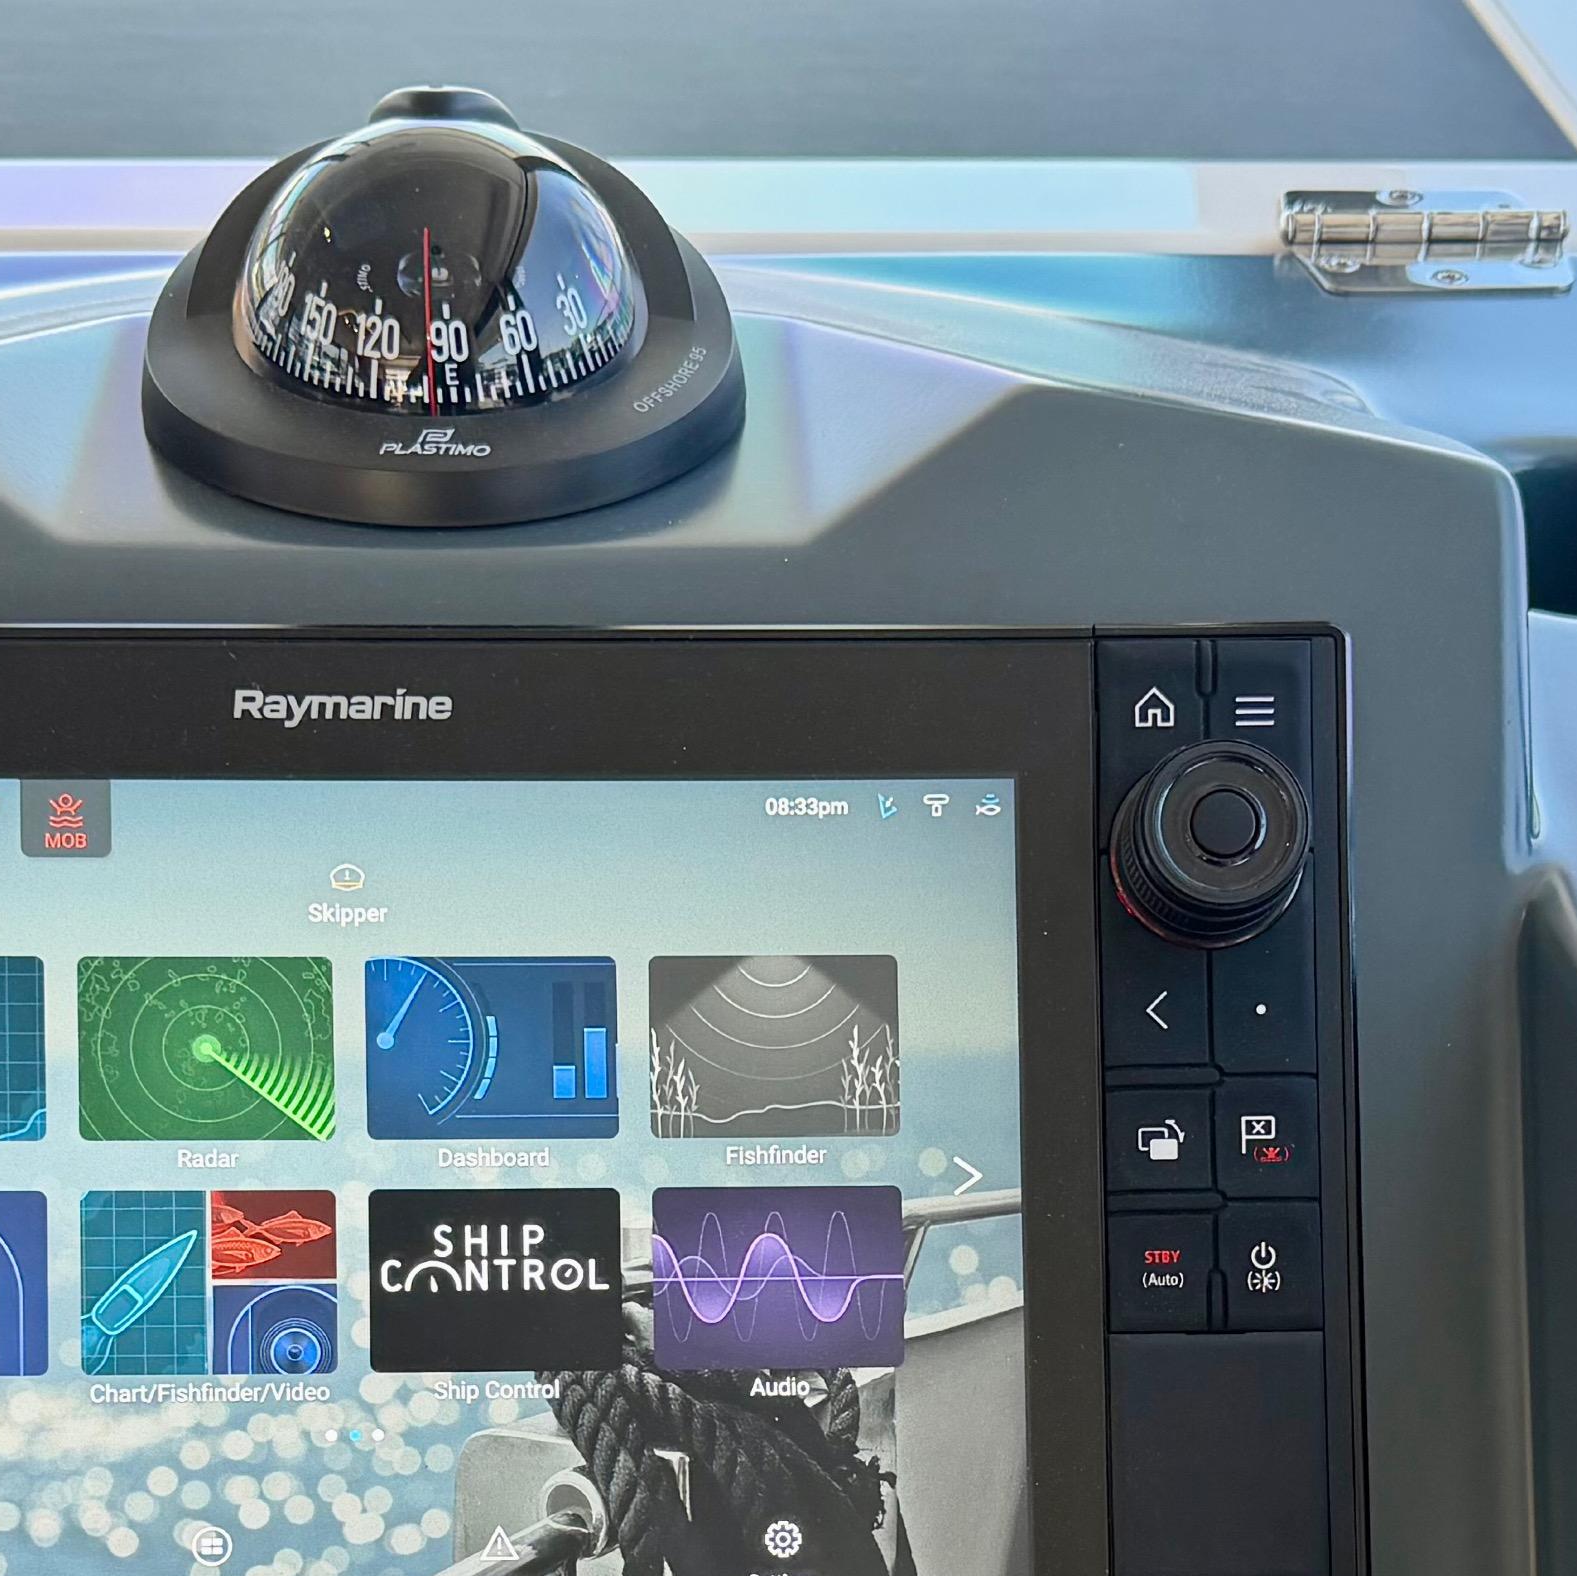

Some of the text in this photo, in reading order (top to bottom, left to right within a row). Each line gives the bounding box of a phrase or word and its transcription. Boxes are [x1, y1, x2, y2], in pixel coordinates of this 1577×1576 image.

[301, 293, 338, 346] 150
[357, 313, 400, 360] 120
[429, 320, 469, 363] 90
[499, 311, 538, 355] 60
[556, 287, 588, 336] 30
[445, 363, 459, 386] E
[633, 346, 708, 414] OFFSHORE 95
[379, 442, 491, 457] PLASTIMO
[233, 688, 454, 728] Raymarine
[765, 797, 849, 818] 08:33pm
[44, 833, 88, 850] MOB
[308, 903, 388, 928] Skipper
[177, 1148, 239, 1169] Radar
[438, 1147, 550, 1168] Dashboard
[726, 1145, 827, 1165] Fishfinder
[434, 1224, 545, 1257] SHIP
[1144, 1250, 1181, 1264] STBY
[1142, 1272, 1184, 1289] (Auto)
[90, 1382, 330, 1404] Chart/Fishfinder/Video
[434, 1379, 560, 1404] Ship Control
[749, 1377, 811, 1398] Audio
